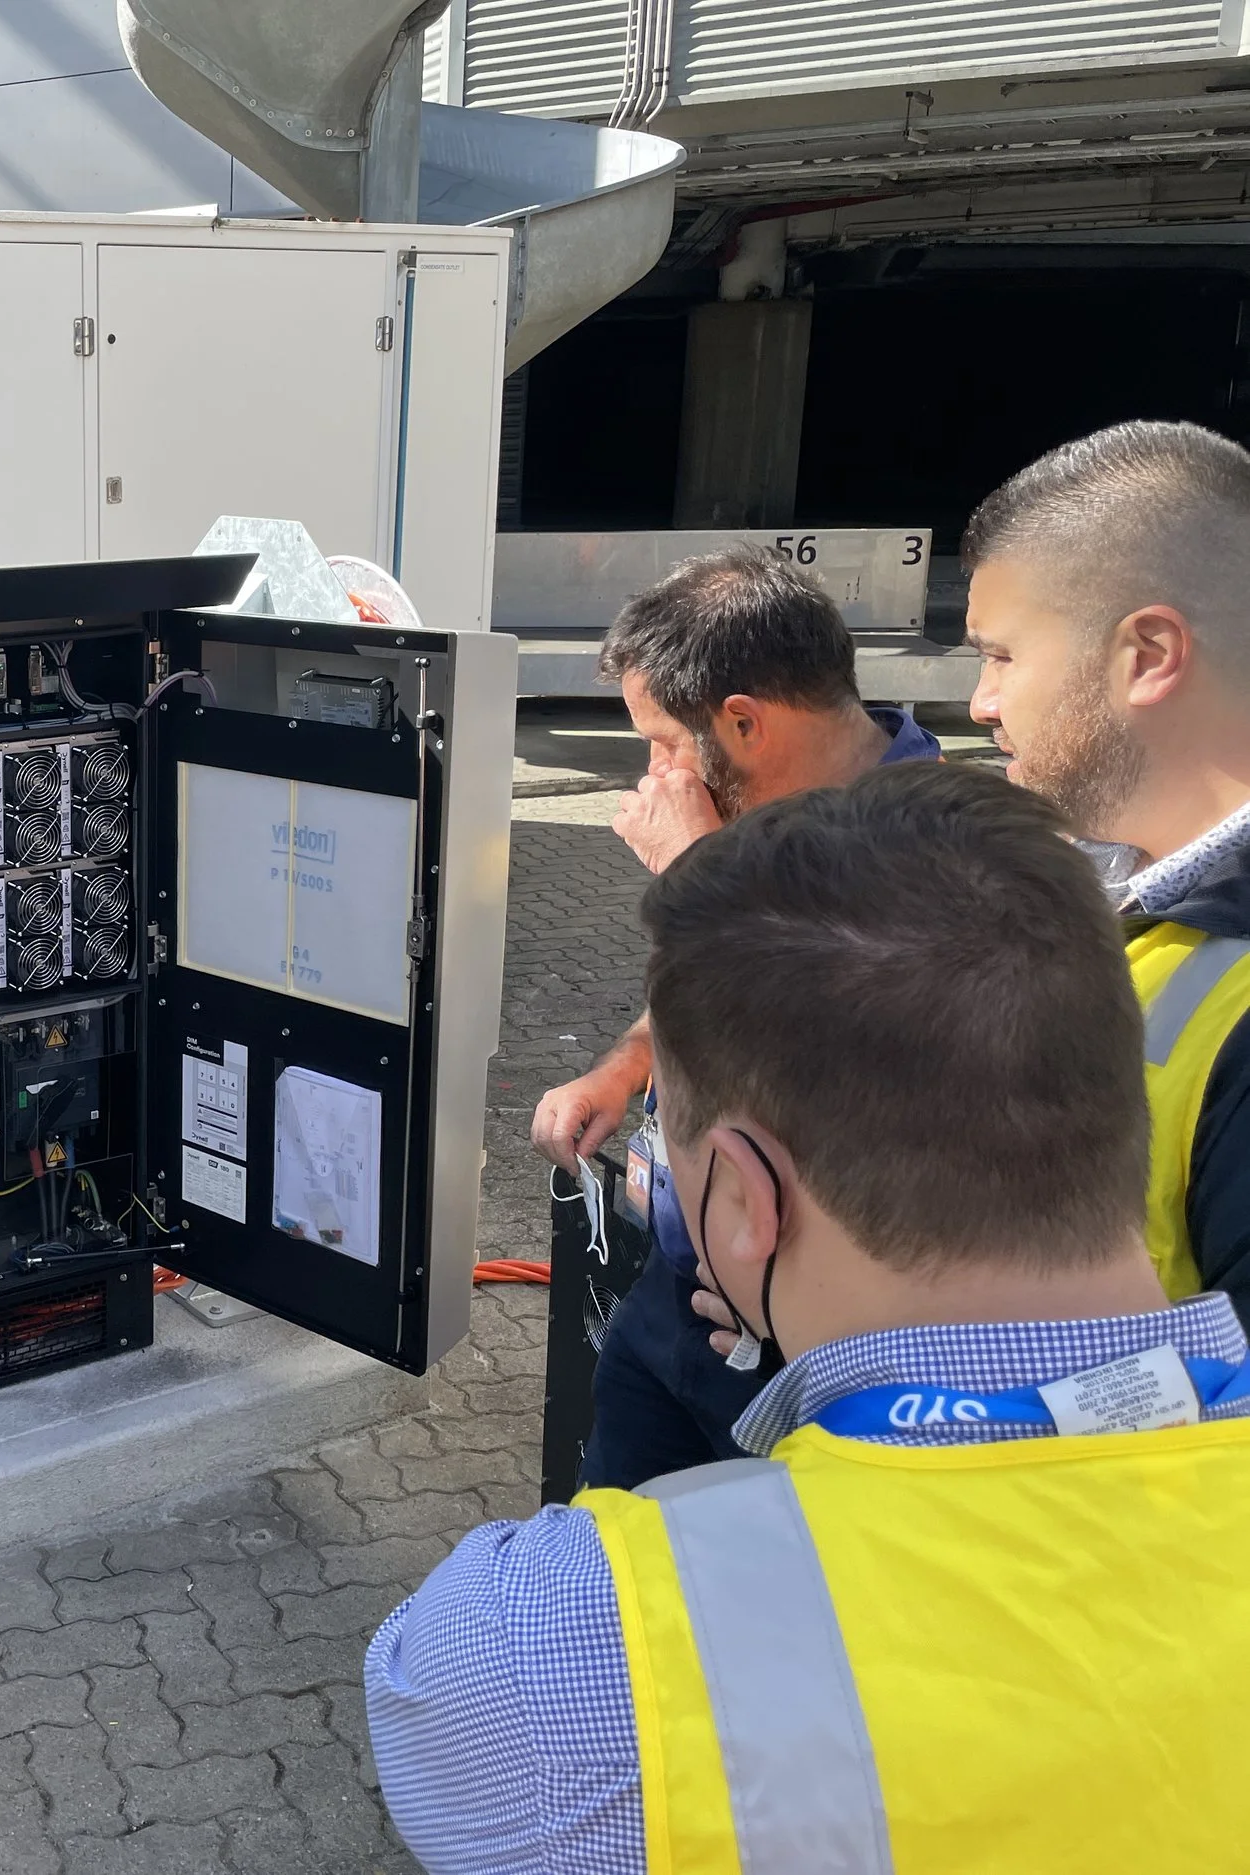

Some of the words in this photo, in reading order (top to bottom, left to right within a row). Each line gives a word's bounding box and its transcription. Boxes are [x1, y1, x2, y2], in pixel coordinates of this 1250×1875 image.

[902, 535, 923, 565] 3
[298, 965, 322, 984] 779
[186, 1043, 221, 1058] Configuration
[1104, 1366, 1113, 1374] IN
[1115, 1357, 1140, 1371] MADE
[1074, 1369, 1104, 1383] CHINA
[888, 1393, 988, 1428] SYD
